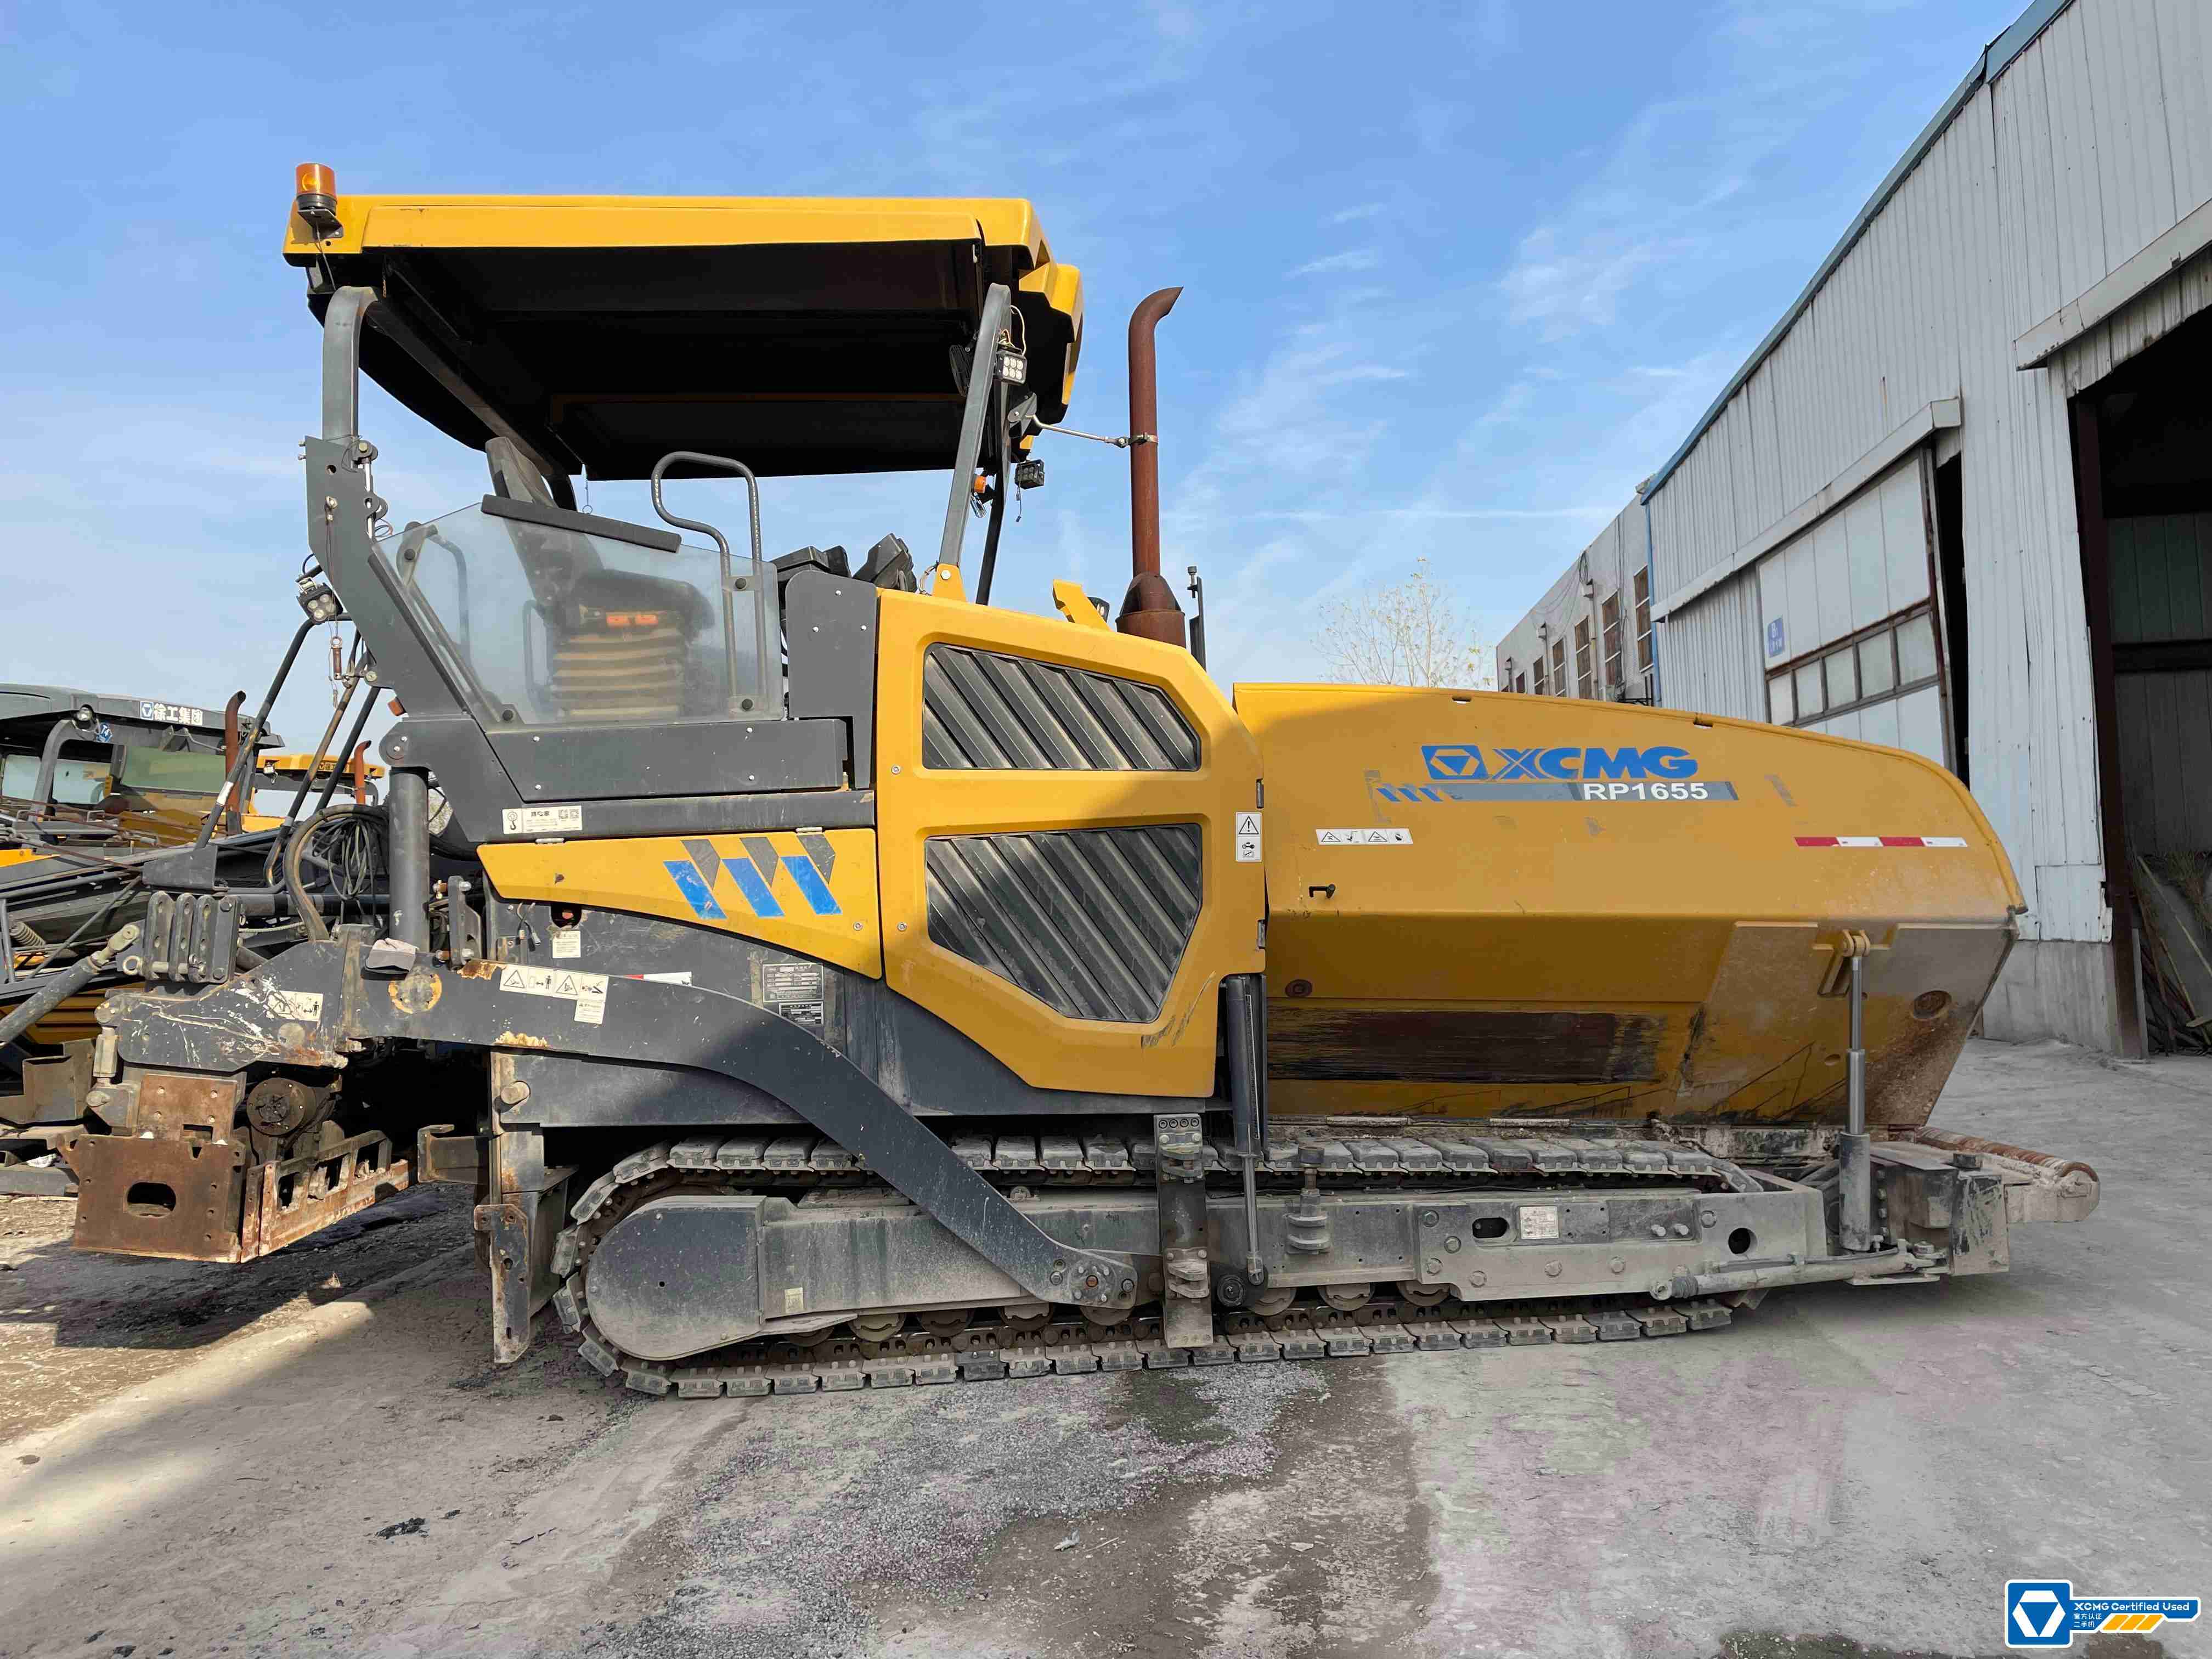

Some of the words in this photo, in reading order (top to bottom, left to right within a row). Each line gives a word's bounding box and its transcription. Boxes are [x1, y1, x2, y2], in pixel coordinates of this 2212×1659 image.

[154, 703, 203, 725] 徐工集团
[1492, 746, 1699, 780] XCMG
[1583, 782, 1708, 800] RP1655
